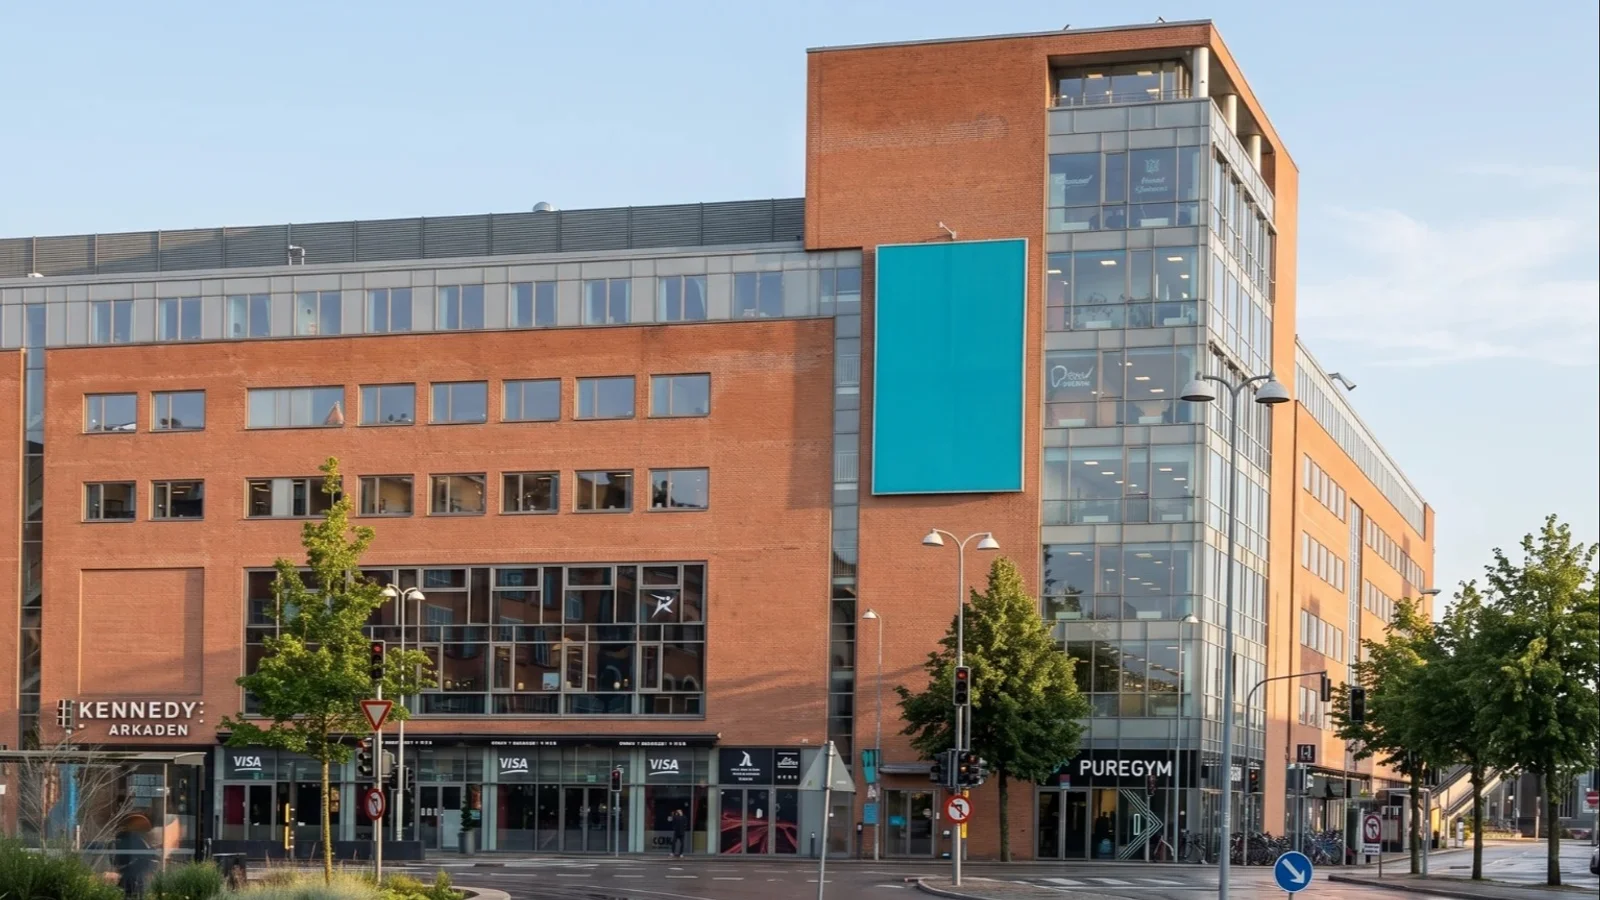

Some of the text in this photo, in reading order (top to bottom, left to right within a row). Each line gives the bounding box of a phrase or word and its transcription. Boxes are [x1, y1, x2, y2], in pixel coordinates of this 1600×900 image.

[79, 701, 196, 719] KENNEDY
[108, 724, 188, 736] ARKADEN
[233, 756, 262, 767] VISA
[499, 757, 528, 769] VISA
[649, 759, 679, 770] VISA
[1080, 760, 1172, 776] PUREGYM
